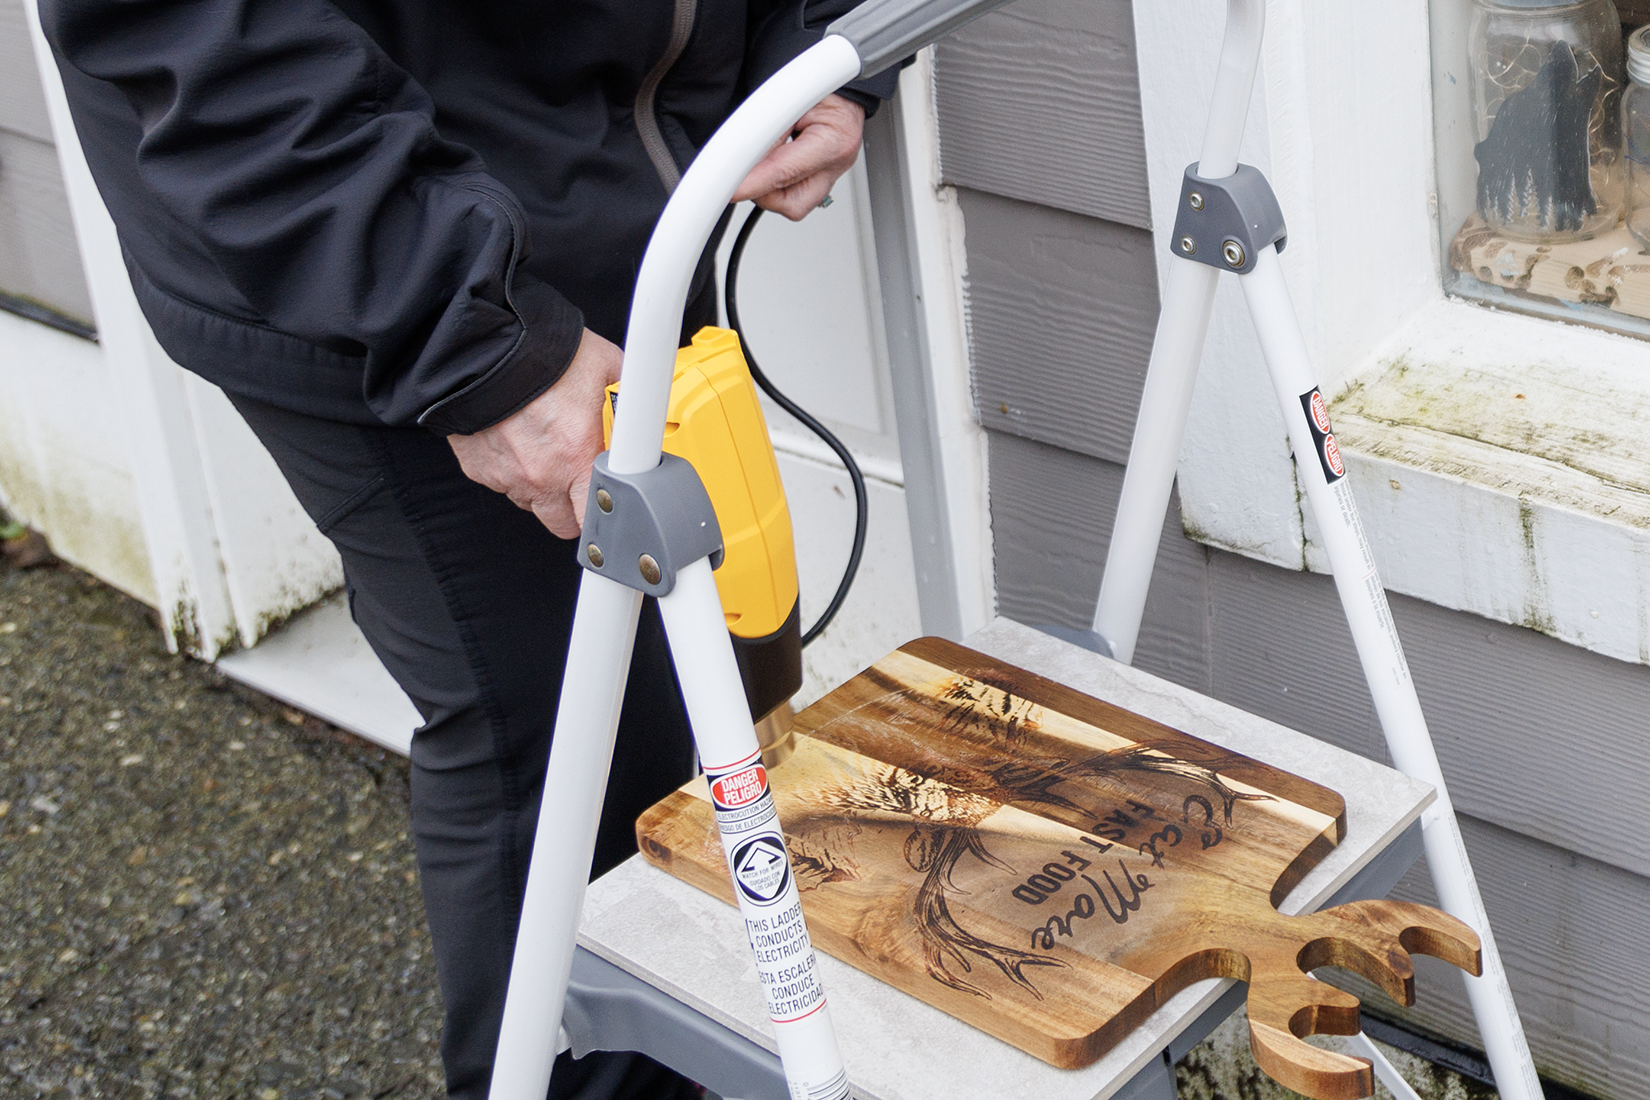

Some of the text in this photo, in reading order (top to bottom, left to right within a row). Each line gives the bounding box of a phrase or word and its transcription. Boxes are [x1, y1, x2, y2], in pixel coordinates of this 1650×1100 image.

[1313, 396, 1329, 429] DANGER
[1326, 438, 1343, 472] PELIGRO
[721, 768, 759, 792] DANGER
[724, 781, 762, 805] PELIGRO
[1012, 800, 1157, 906] FAST FOOD
[1031, 794, 1223, 950] Eat More
[749, 919, 768, 932] THIS
[756, 920, 803, 948] CONDUCTS
[757, 933, 808, 963] ELECTRICITY
[759, 971, 777, 984] ESTA
[772, 973, 815, 1000] CONDUCE
